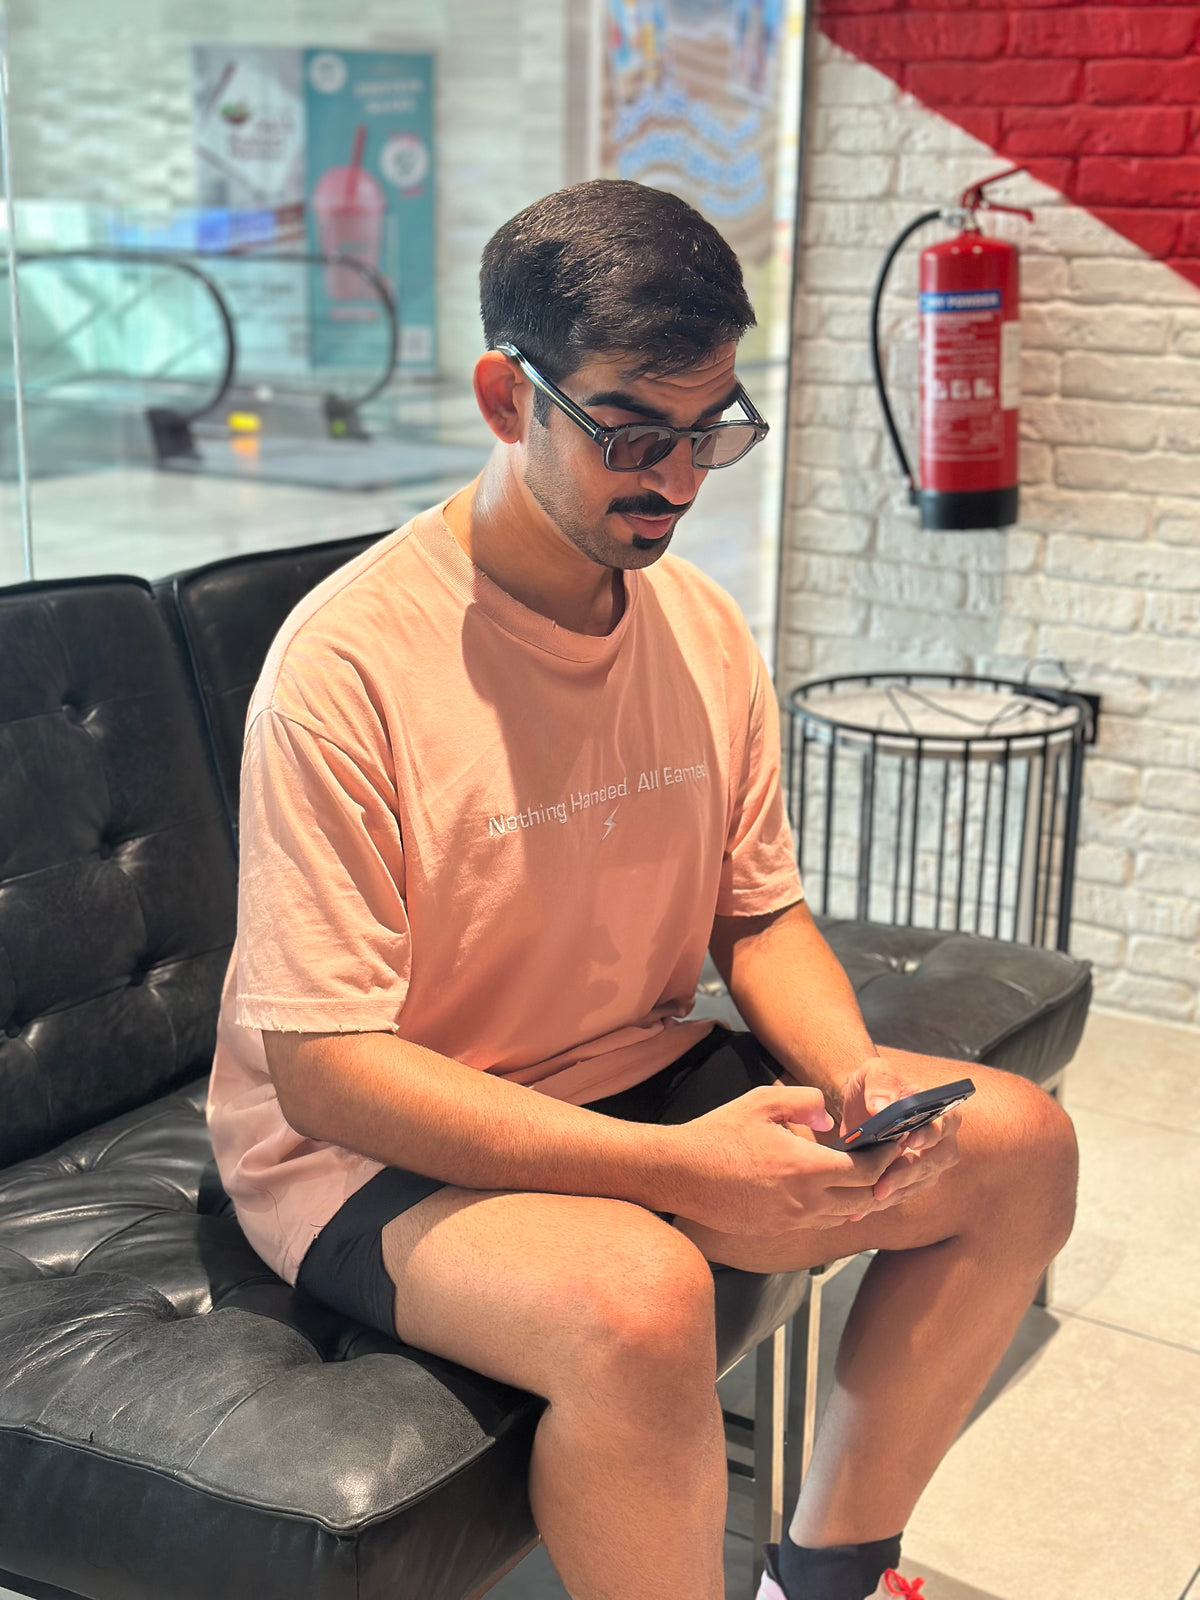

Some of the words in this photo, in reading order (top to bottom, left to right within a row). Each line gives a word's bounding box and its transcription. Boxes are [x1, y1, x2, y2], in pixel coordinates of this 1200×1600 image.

[488, 802, 568, 837] Nothing
[570, 777, 631, 813] Handed.
[638, 770, 659, 793] All
